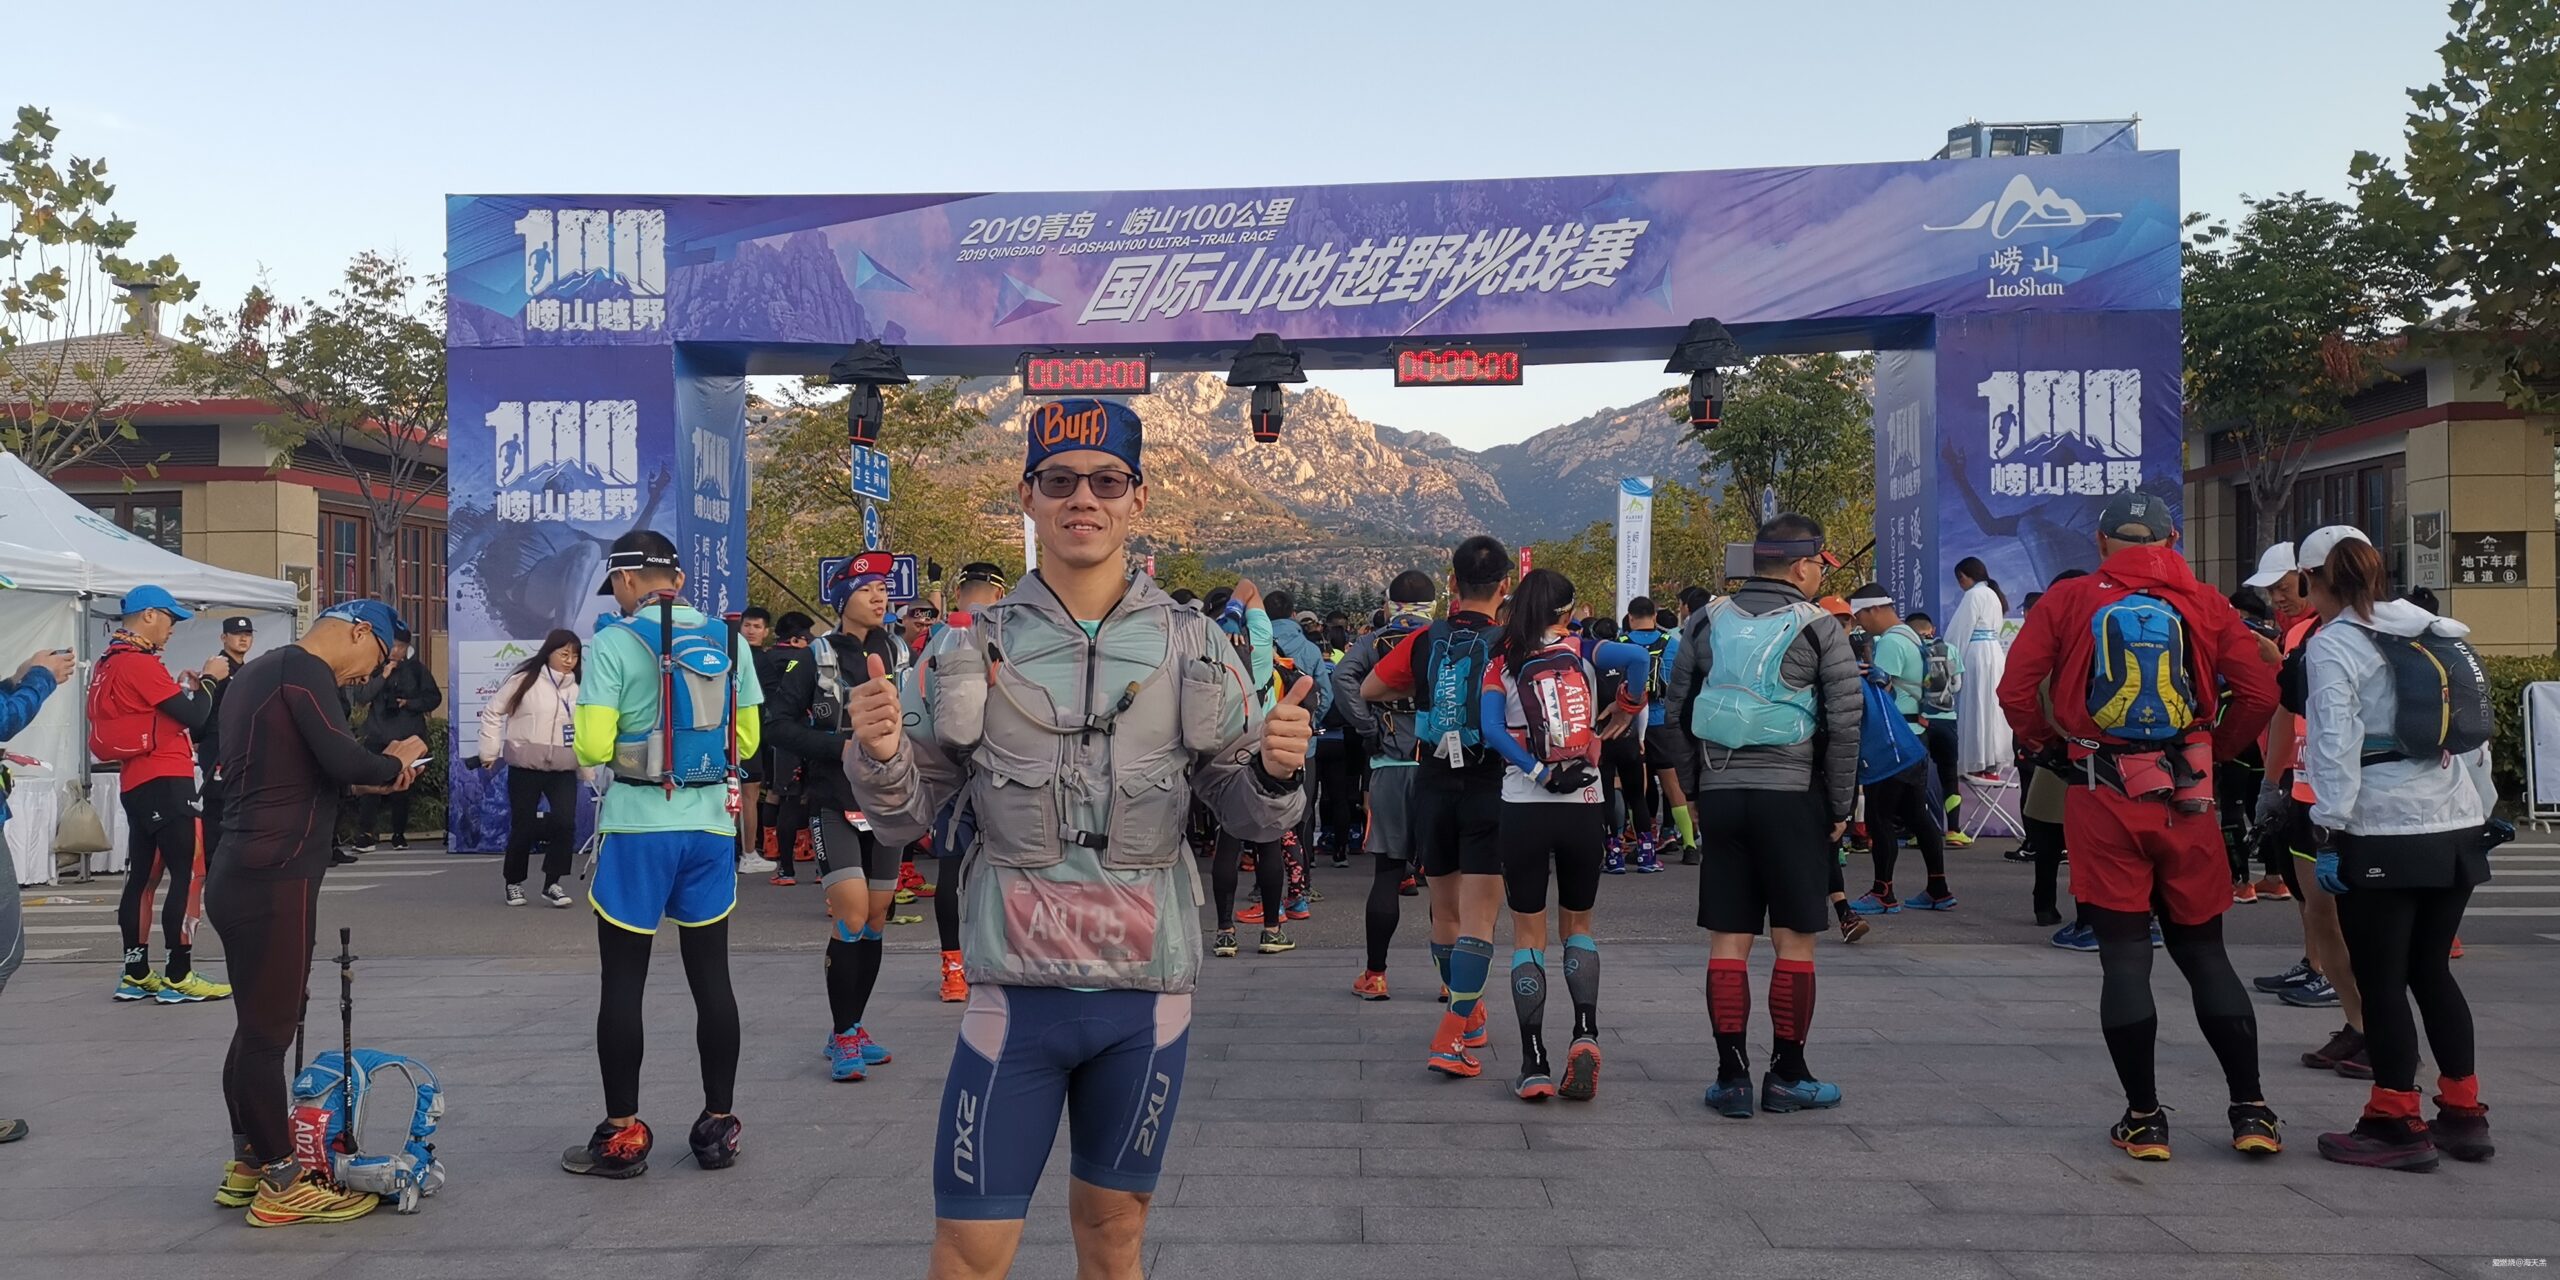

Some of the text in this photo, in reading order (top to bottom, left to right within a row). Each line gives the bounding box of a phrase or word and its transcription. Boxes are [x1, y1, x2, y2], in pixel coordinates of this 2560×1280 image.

[956, 229, 1278, 263] 2019 QINGDAO LAOSHAN100 ULTRA-TRAIL RACE
[1989, 246, 2059, 275] 崂山
[1077, 217, 1650, 328] 国际山地越野挑战赛
[1986, 277, 2065, 298] LaoShan
[526, 299, 666, 331] 崂山越野
[1028, 359, 1146, 389] 00:00:00
[1398, 350, 1518, 381] 00:00:00
[1990, 460, 2142, 497] 崂山越野
[496, 488, 638, 522] 崂山越野
[2461, 555, 2517, 567] 地下车库
[1564, 684, 1588, 734] A1014
[1133, 1071, 1171, 1157] 2XU
[953, 1088, 977, 1185] 2XU
